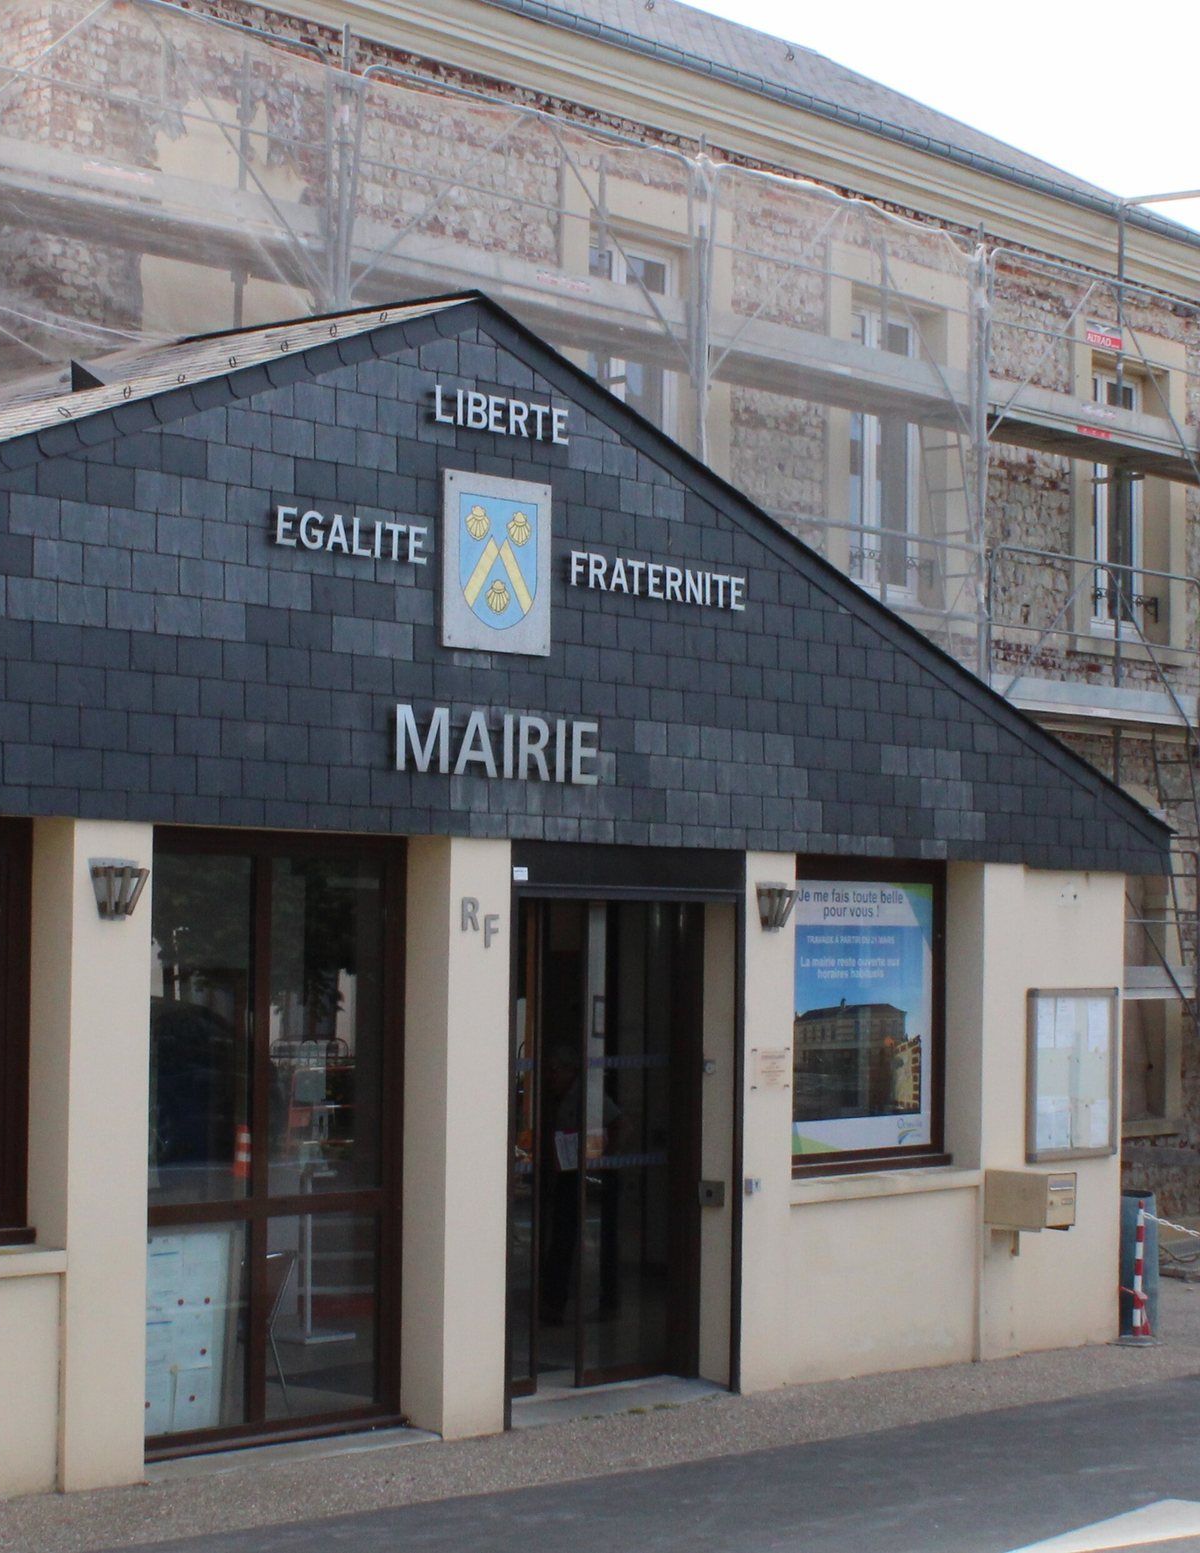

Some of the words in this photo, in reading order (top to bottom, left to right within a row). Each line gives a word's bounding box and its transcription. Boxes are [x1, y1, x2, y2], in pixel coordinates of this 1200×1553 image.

[434, 385, 569, 445] LIBERTE
[275, 505, 428, 565] EGALITE
[570, 550, 746, 611] FRATERNITE
[396, 704, 599, 785] MAIRIE
[798, 889, 810, 902] Je
[813, 892, 828, 902] me
[832, 888, 849, 903] fais
[853, 890, 877, 903] toute
[881, 890, 903, 904] belle
[823, 906, 847, 920] pour
[849, 906, 873, 918] vous
